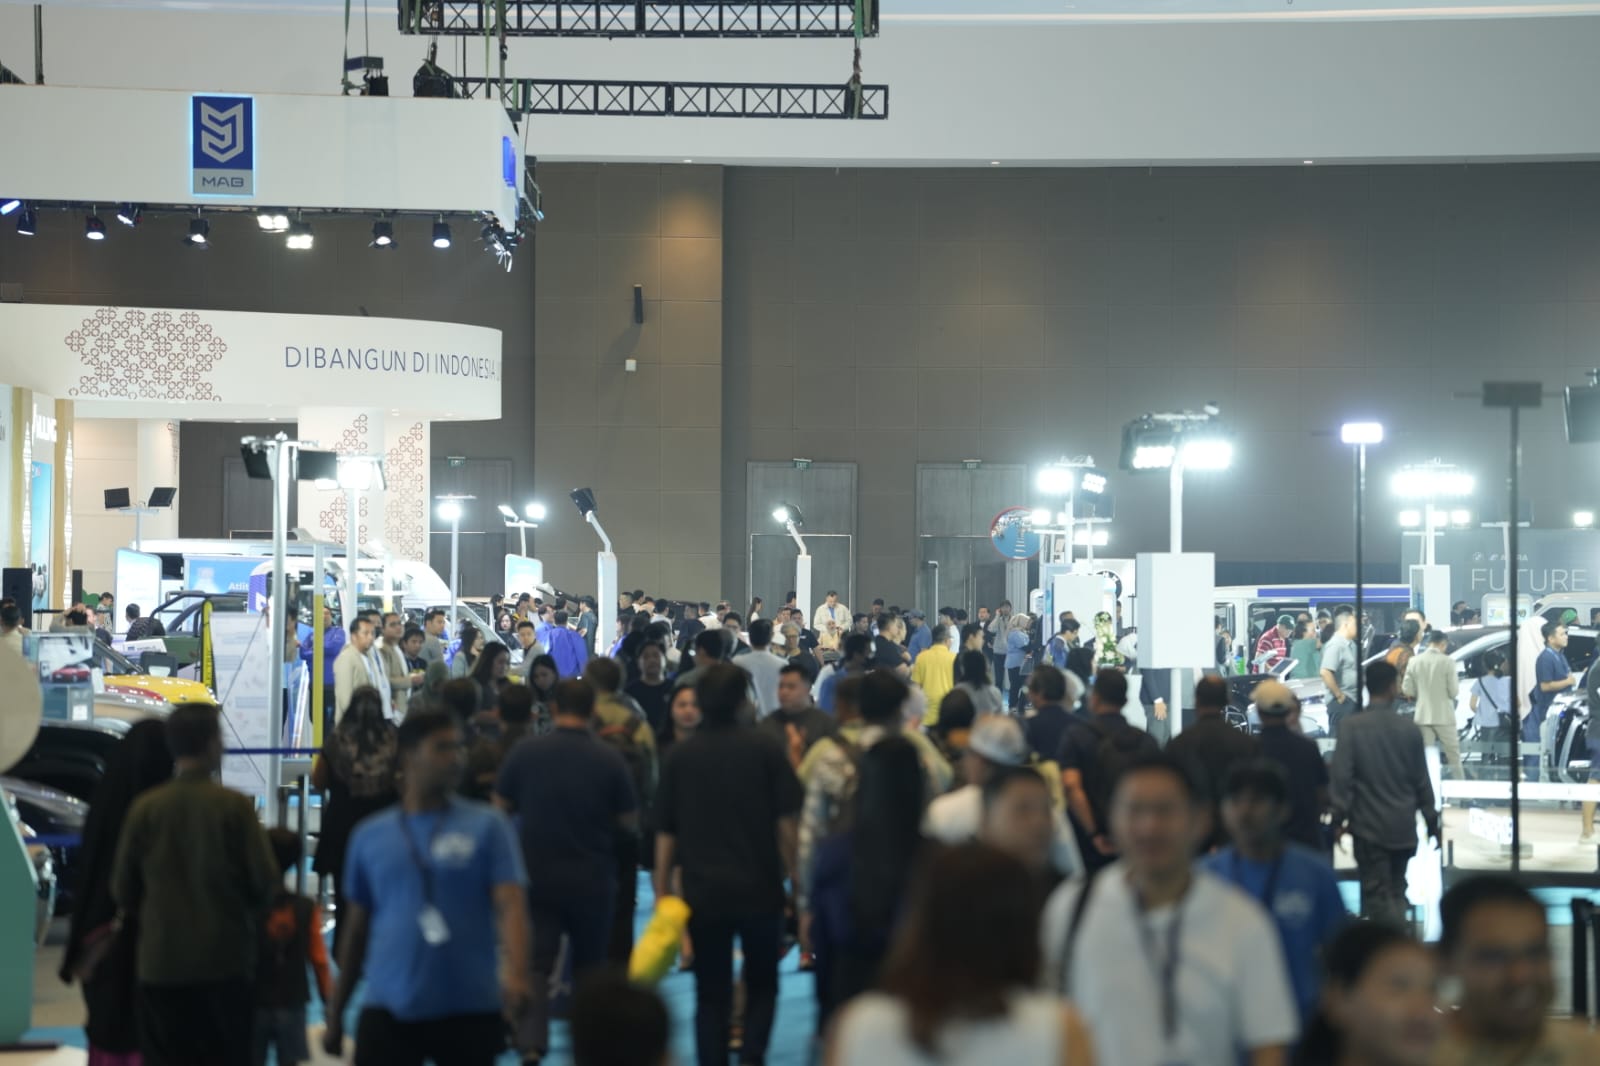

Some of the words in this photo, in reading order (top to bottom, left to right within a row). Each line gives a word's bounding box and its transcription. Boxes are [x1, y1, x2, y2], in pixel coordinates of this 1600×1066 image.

[202, 176, 244, 188] MAB
[285, 346, 406, 372] DIBANGUN
[413, 351, 429, 374] DI
